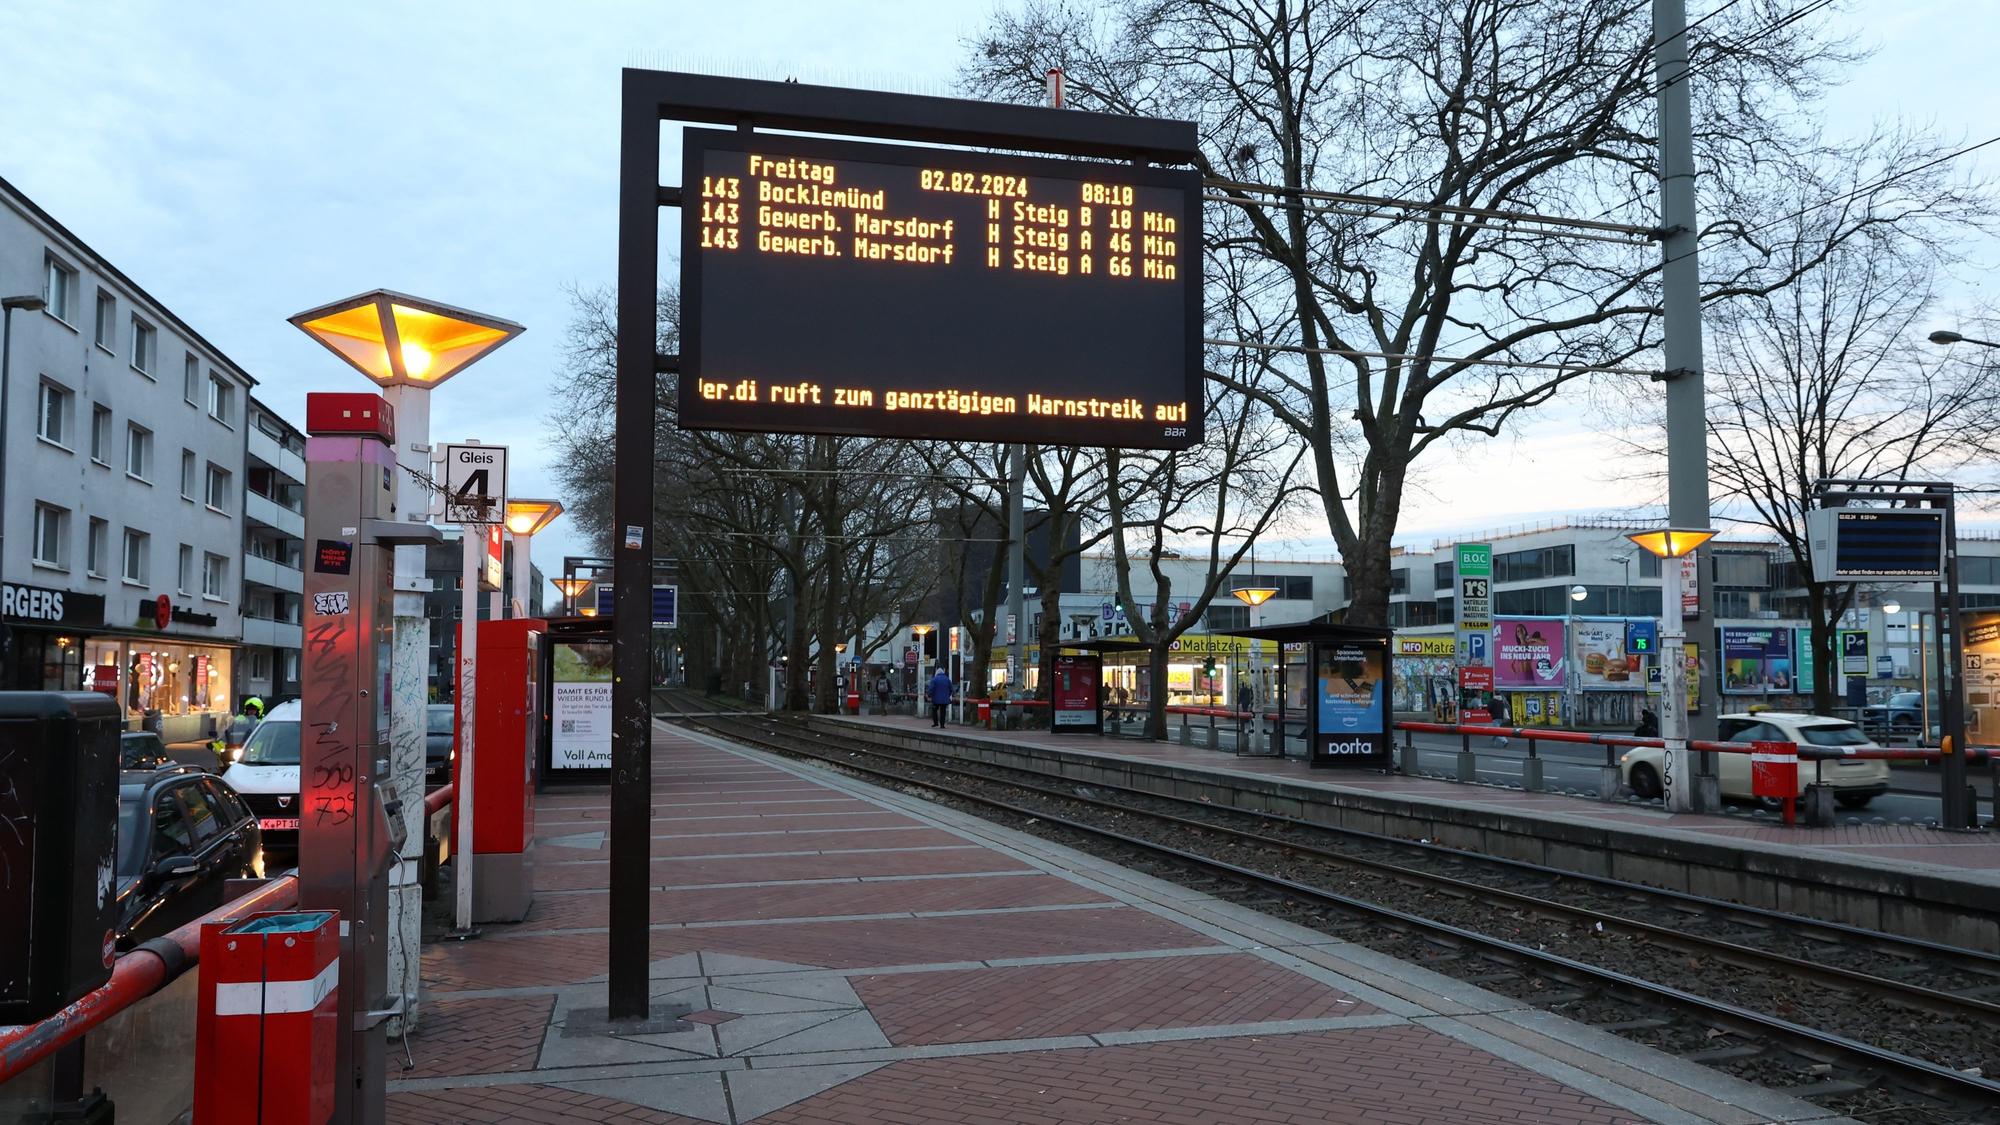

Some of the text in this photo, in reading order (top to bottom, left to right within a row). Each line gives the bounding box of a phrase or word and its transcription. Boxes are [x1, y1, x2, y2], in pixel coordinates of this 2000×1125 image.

[750, 155, 1133, 206] Freitag 02.02.2024 08:10
[702, 176, 1175, 233] 143 Bocklemünd H Steig B 10 Min
[702, 201, 1176, 257] 143 Gewerb. Marsdorf H Steig A 46 Min
[701, 226, 1176, 280] 143 Gewerb. Marsdorf H Steig A 66 Min
[699, 378, 757, 401] er.di
[771, 383, 821, 404] ruft
[834, 388, 872, 406] zum
[886, 390, 1015, 416] ganztägigen
[1028, 393, 1143, 420] Warnstreik
[459, 451, 494, 464] Gleis
[455, 469, 496, 520] 4
[1465, 580, 1487, 597] rs
[1183, 640, 1242, 653] Matratzen
[1402, 642, 1422, 652] MFO
[1471, 636, 1483, 657] P
[1636, 638, 1647, 649] 75
[1846, 634, 1856, 650] P
[584, 687, 593, 695] ES
[594, 687, 608, 695] FÜR
[564, 749, 585, 760] Voll
[1328, 737, 1372, 755] porta
